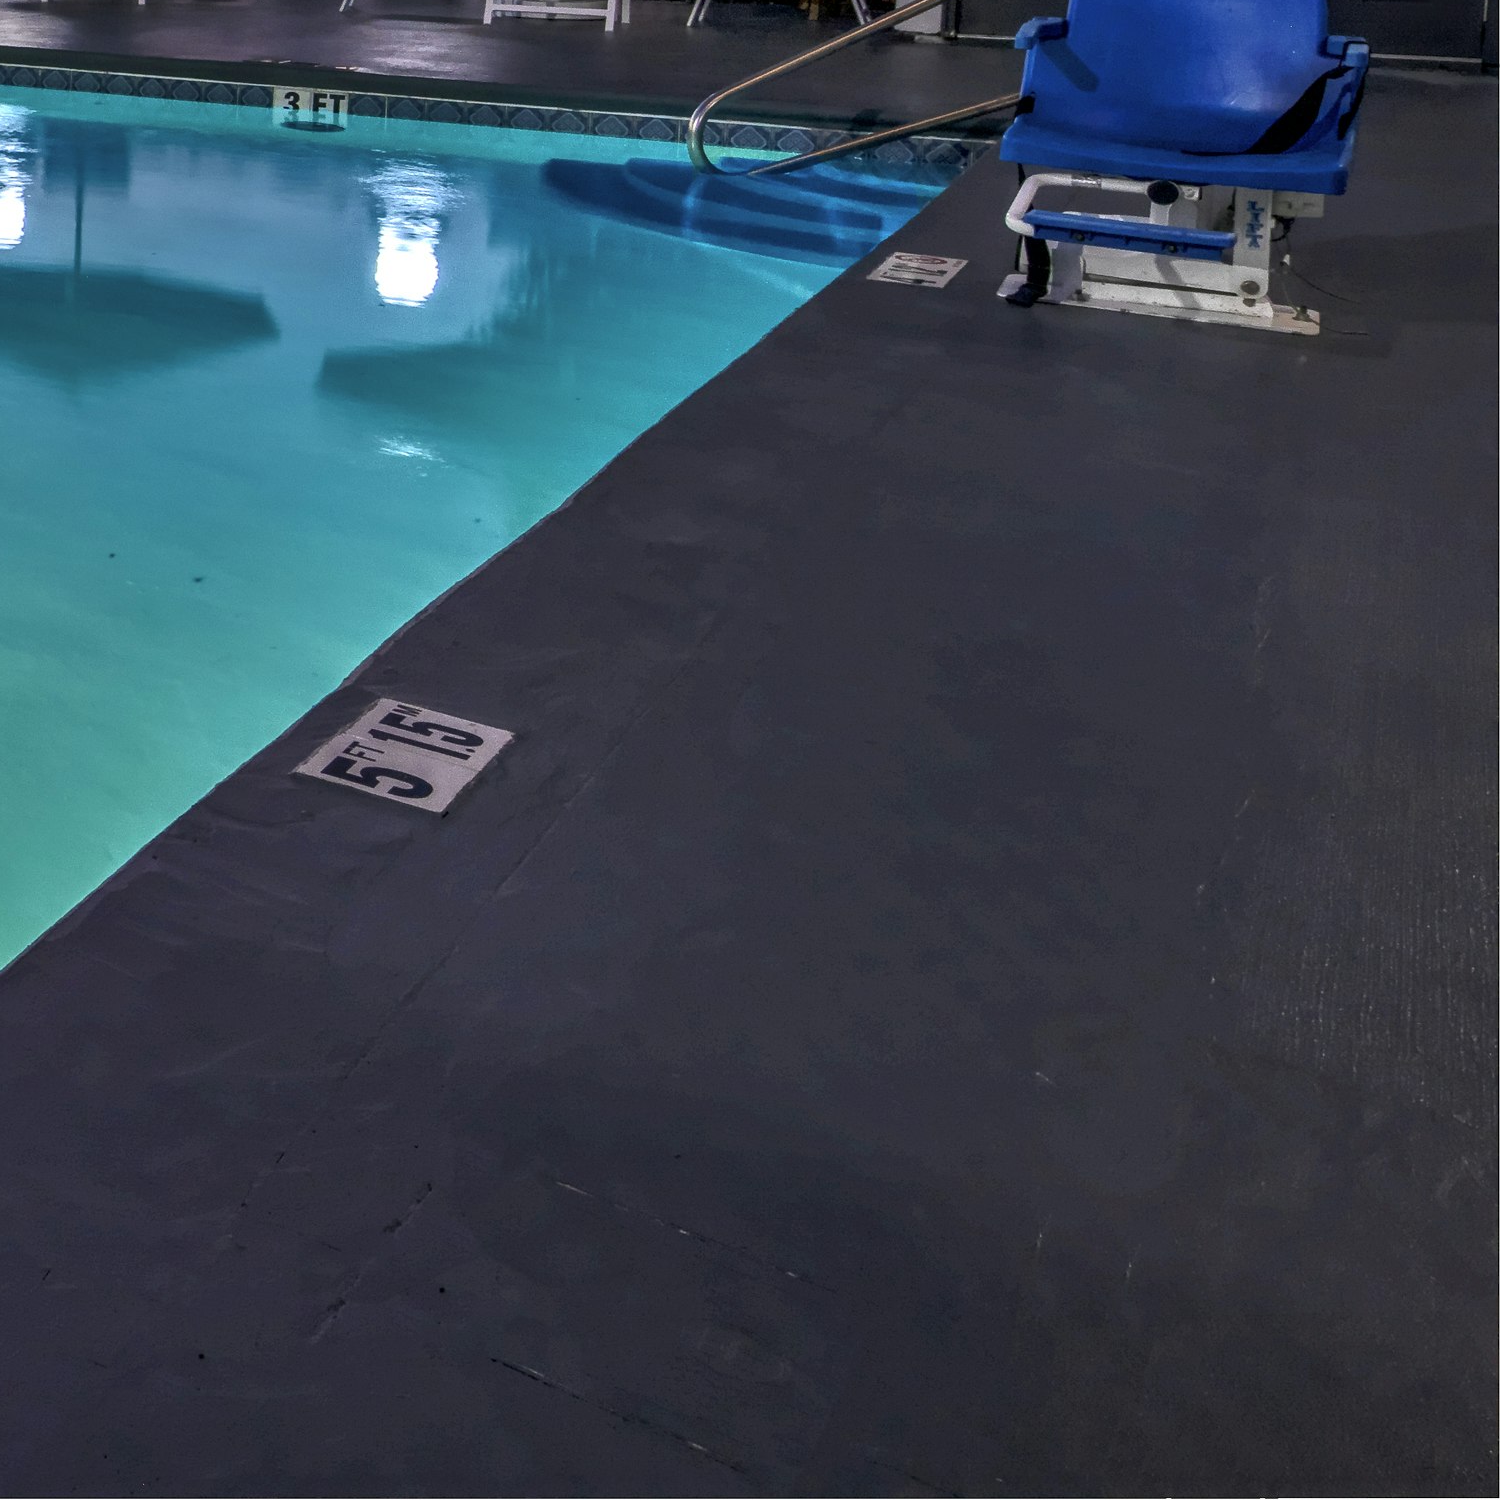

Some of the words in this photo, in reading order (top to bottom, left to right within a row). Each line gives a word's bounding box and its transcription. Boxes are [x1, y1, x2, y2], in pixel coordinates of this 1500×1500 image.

[283, 91, 300, 110] 3
[312, 92, 346, 113] FT
[392, 704, 423, 717] M
[342, 741, 385, 762] FT
[320, 756, 434, 799] 5
